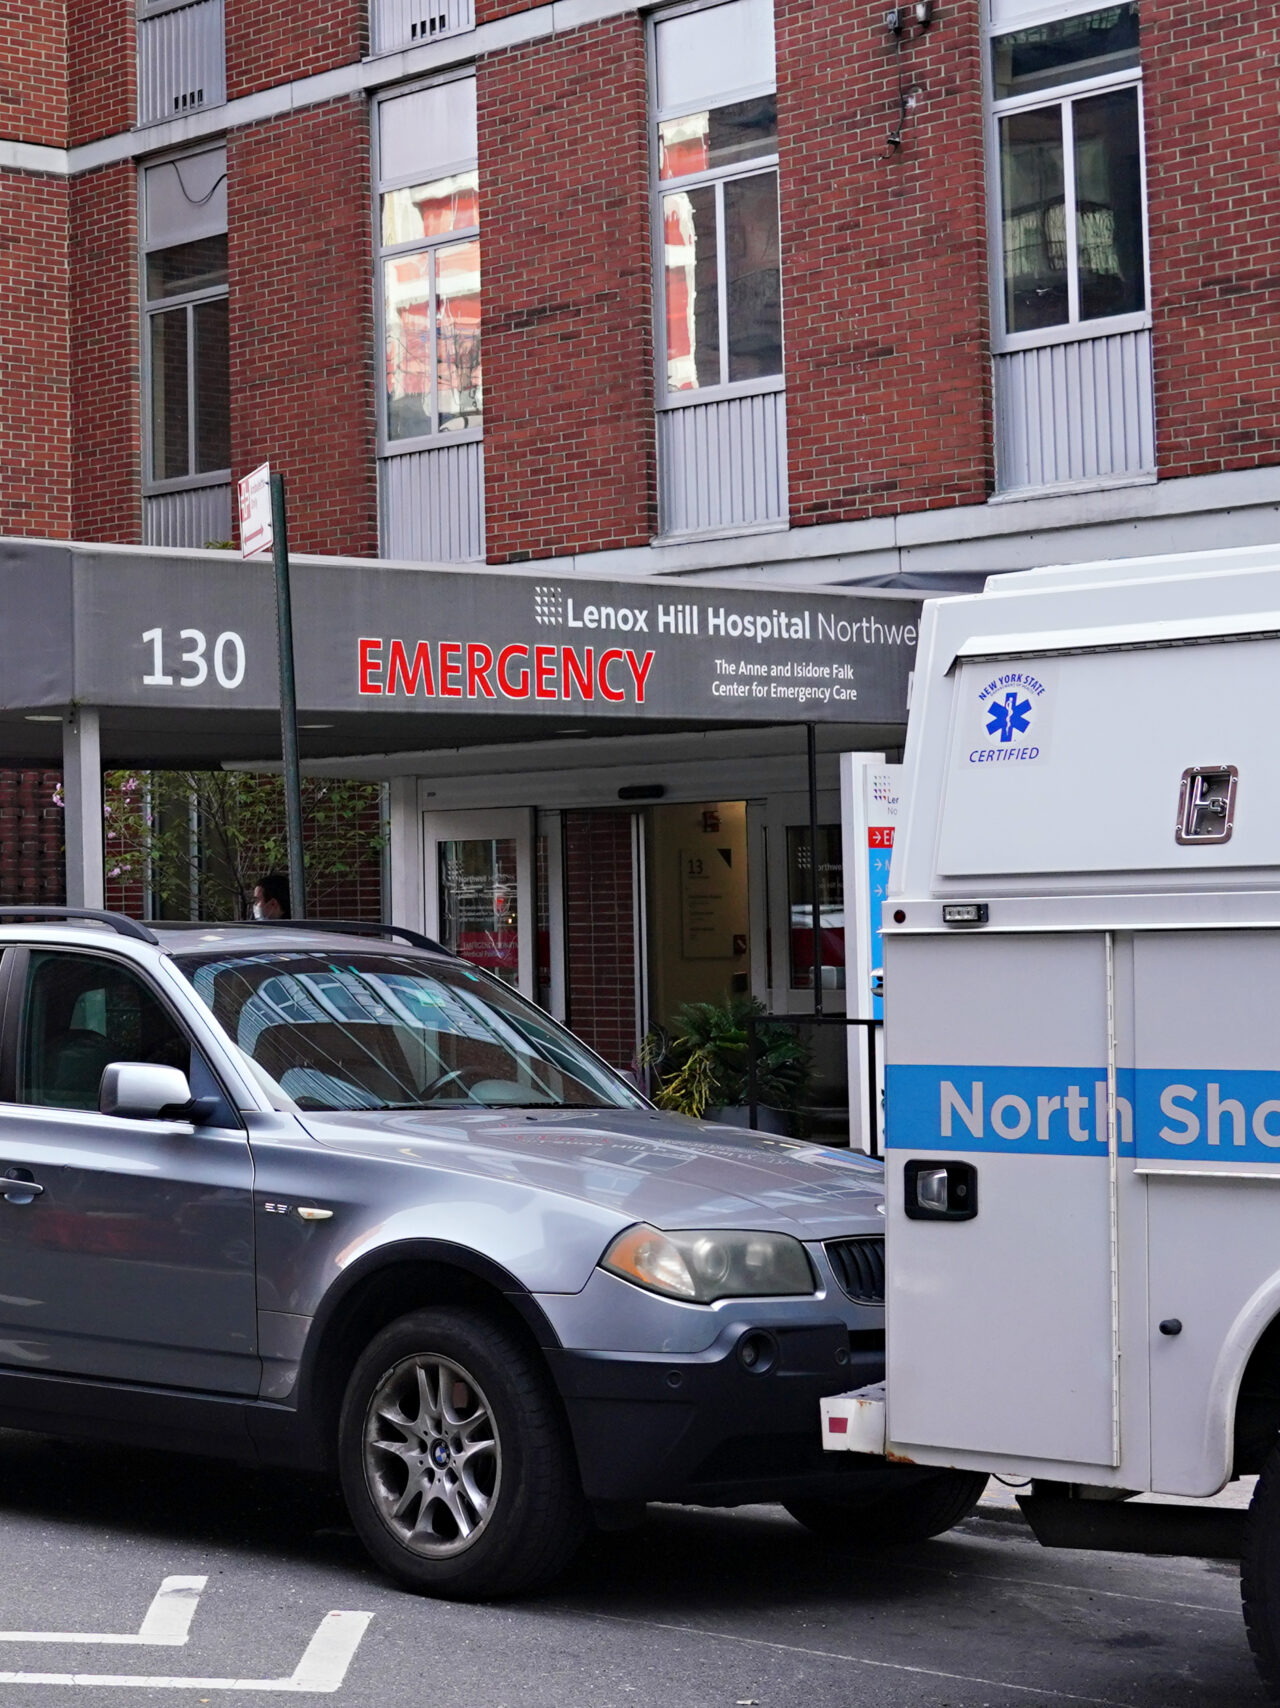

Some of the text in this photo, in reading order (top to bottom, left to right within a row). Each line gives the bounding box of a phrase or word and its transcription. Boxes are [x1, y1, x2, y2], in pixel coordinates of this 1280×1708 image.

[567, 598, 649, 632] Lenox
[657, 604, 699, 635] Hill
[707, 607, 810, 643] Hospital
[140, 627, 246, 689] 130
[357, 637, 656, 704] EMERGENCY
[715, 658, 855, 680] The Anne and Isidore Falk
[711, 681, 858, 703] Center for Emergency Care
[978, 673, 1046, 701] NEW YORK STATE
[969, 747, 1040, 763] CERTIFIED
[940, 1080, 1134, 1144] North
